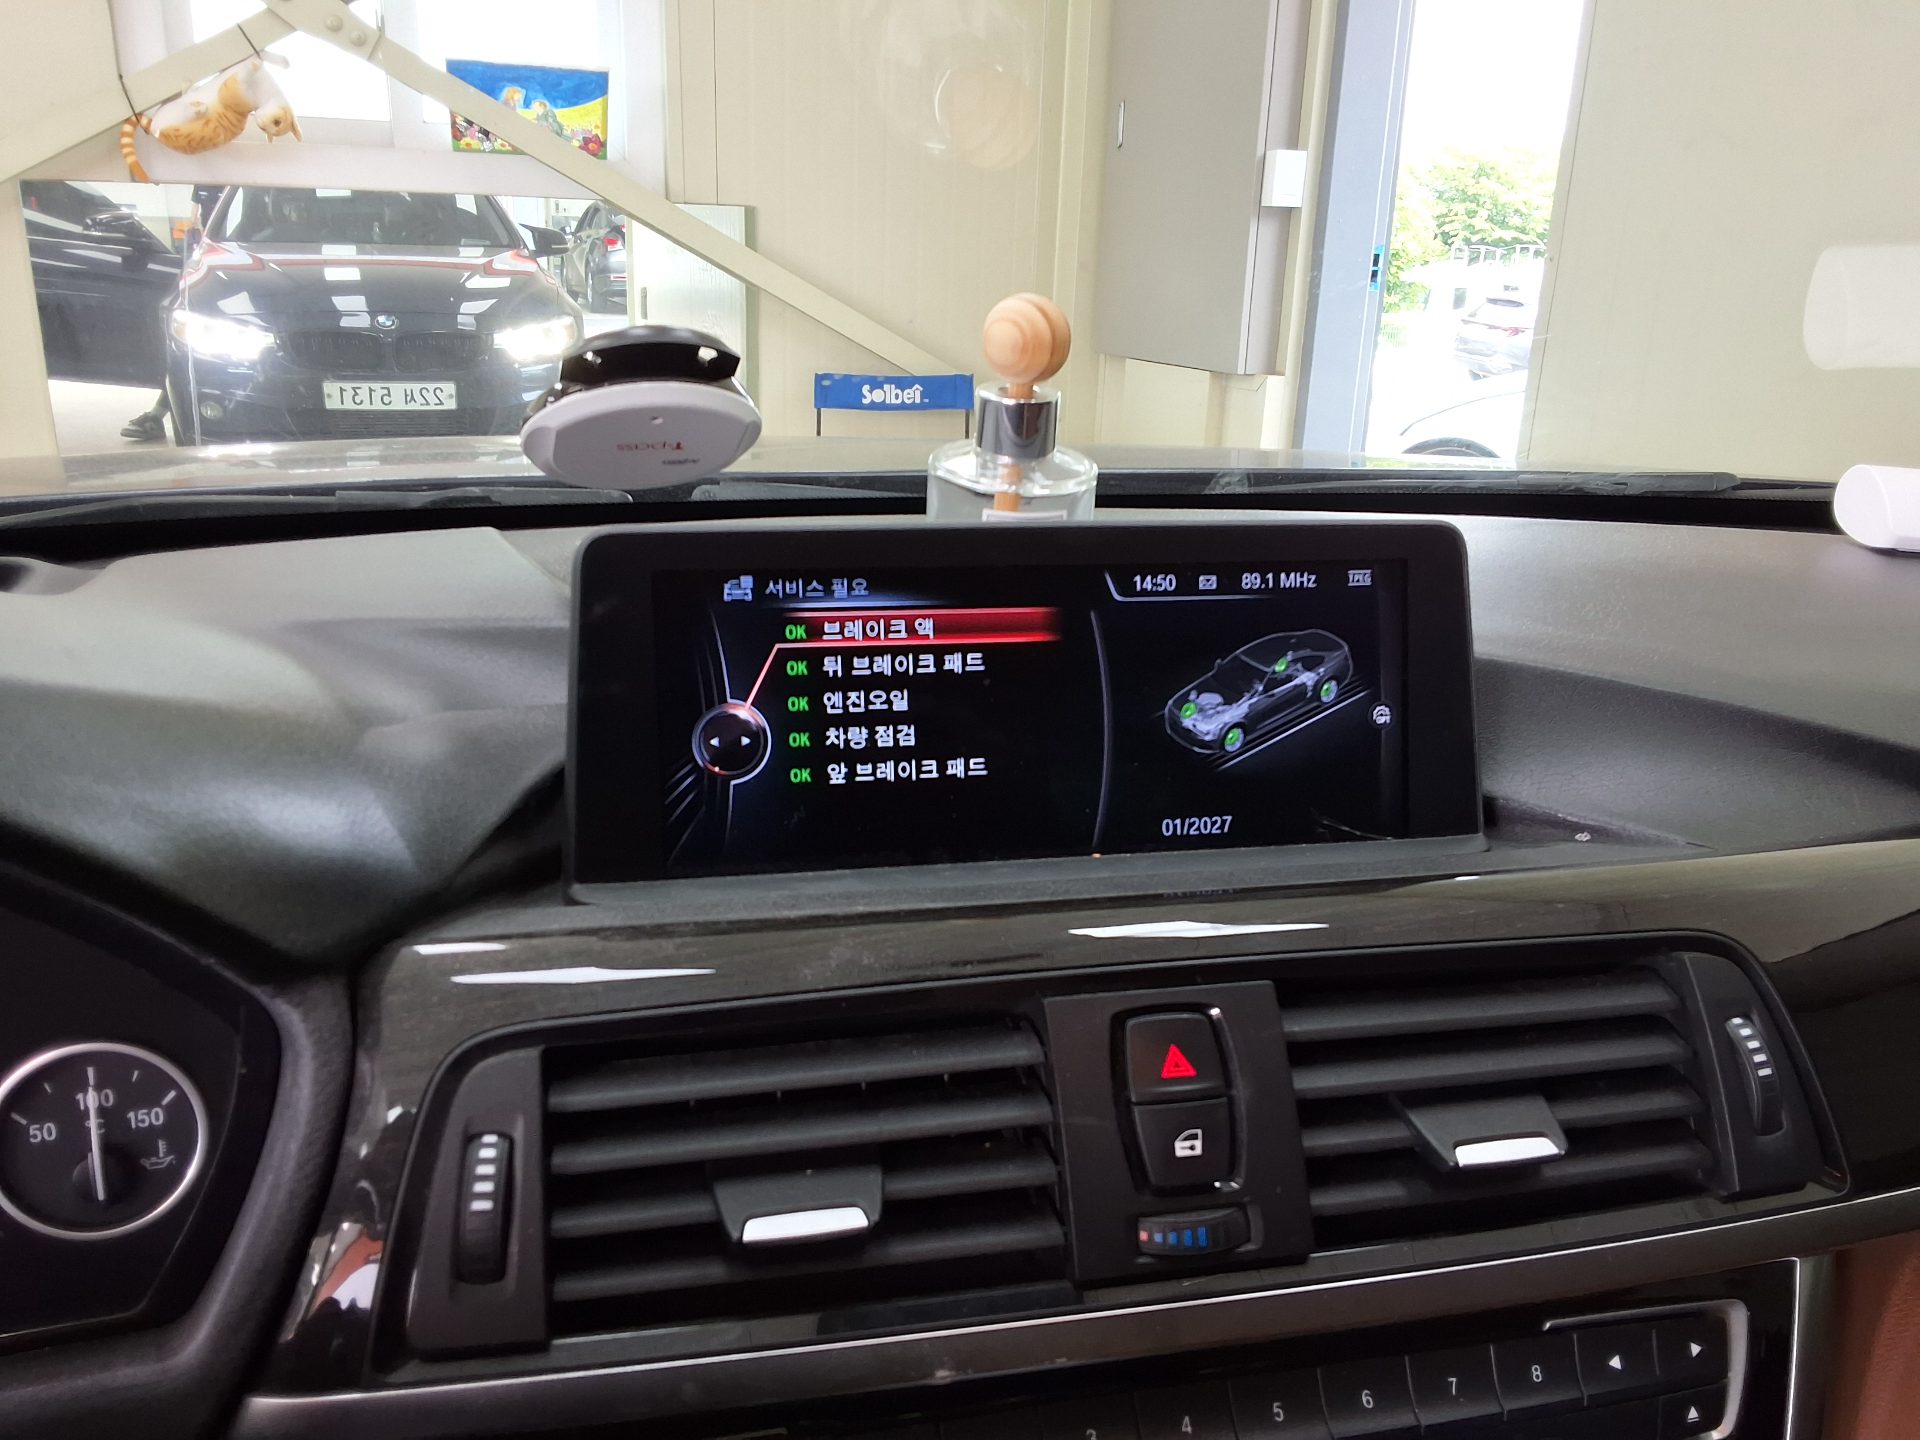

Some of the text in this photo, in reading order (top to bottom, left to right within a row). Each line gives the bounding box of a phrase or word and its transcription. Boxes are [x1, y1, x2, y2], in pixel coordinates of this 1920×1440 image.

[765, 577, 869, 599] 서비스 필요
[1133, 573, 1177, 592] 14:50
[1241, 571, 1317, 590] 89.1 MHz
[785, 617, 935, 641] OK 브레이크 액
[786, 651, 986, 678] OK 뒤 브레이크 패드
[787, 688, 909, 715] OK 엔진오일
[788, 724, 916, 750] OK 차량 점검
[789, 756, 988, 785] OK 앞 브레이크 패드
[1161, 815, 1233, 837] 01/2027
[75, 1088, 114, 1111] 100
[126, 1107, 164, 1129] 150
[29, 1122, 57, 1143] 50
[1531, 1364, 1543, 1383] 8
[1447, 1377, 1457, 1396] 7
[1361, 1389, 1374, 1409] 6
[1272, 1402, 1285, 1422] 5
[1181, 1415, 1193, 1434] 4
